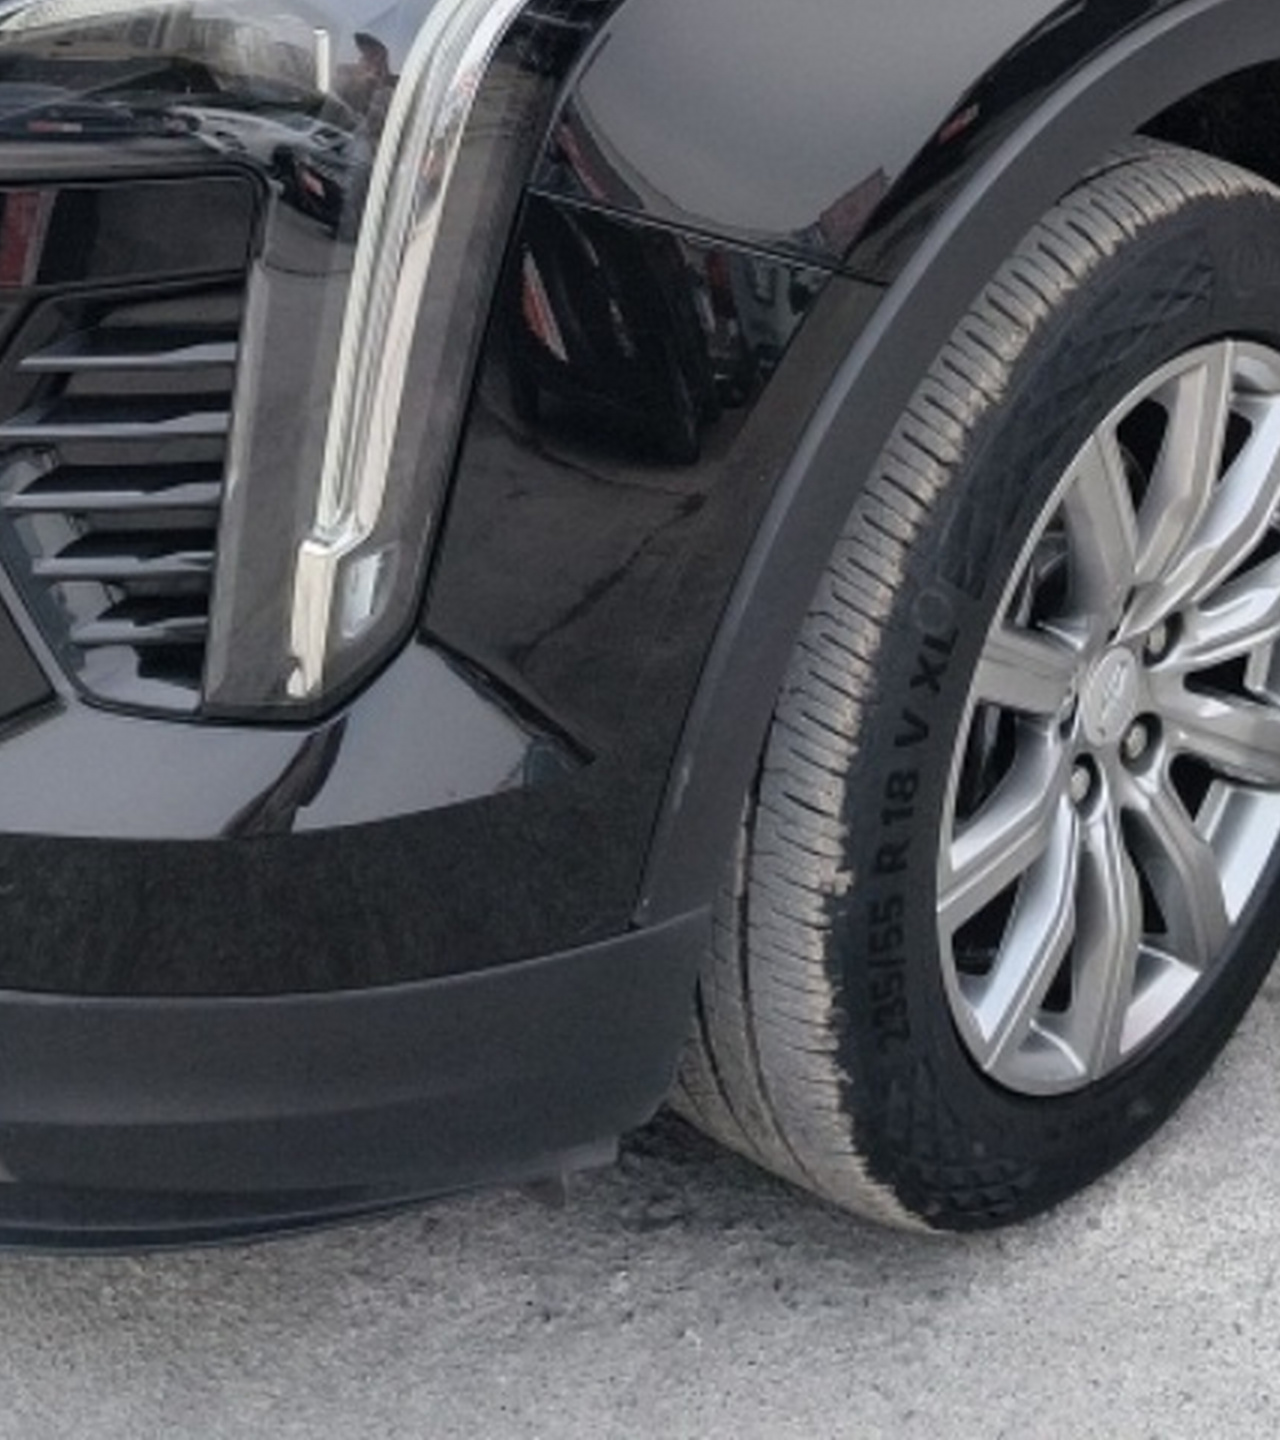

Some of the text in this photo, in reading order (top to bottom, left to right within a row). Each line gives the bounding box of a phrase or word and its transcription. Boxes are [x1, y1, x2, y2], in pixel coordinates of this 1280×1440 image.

[910, 627, 959, 693] XL
[894, 709, 929, 747] V
[881, 771, 919, 826] 18
[876, 837, 911, 875] R
